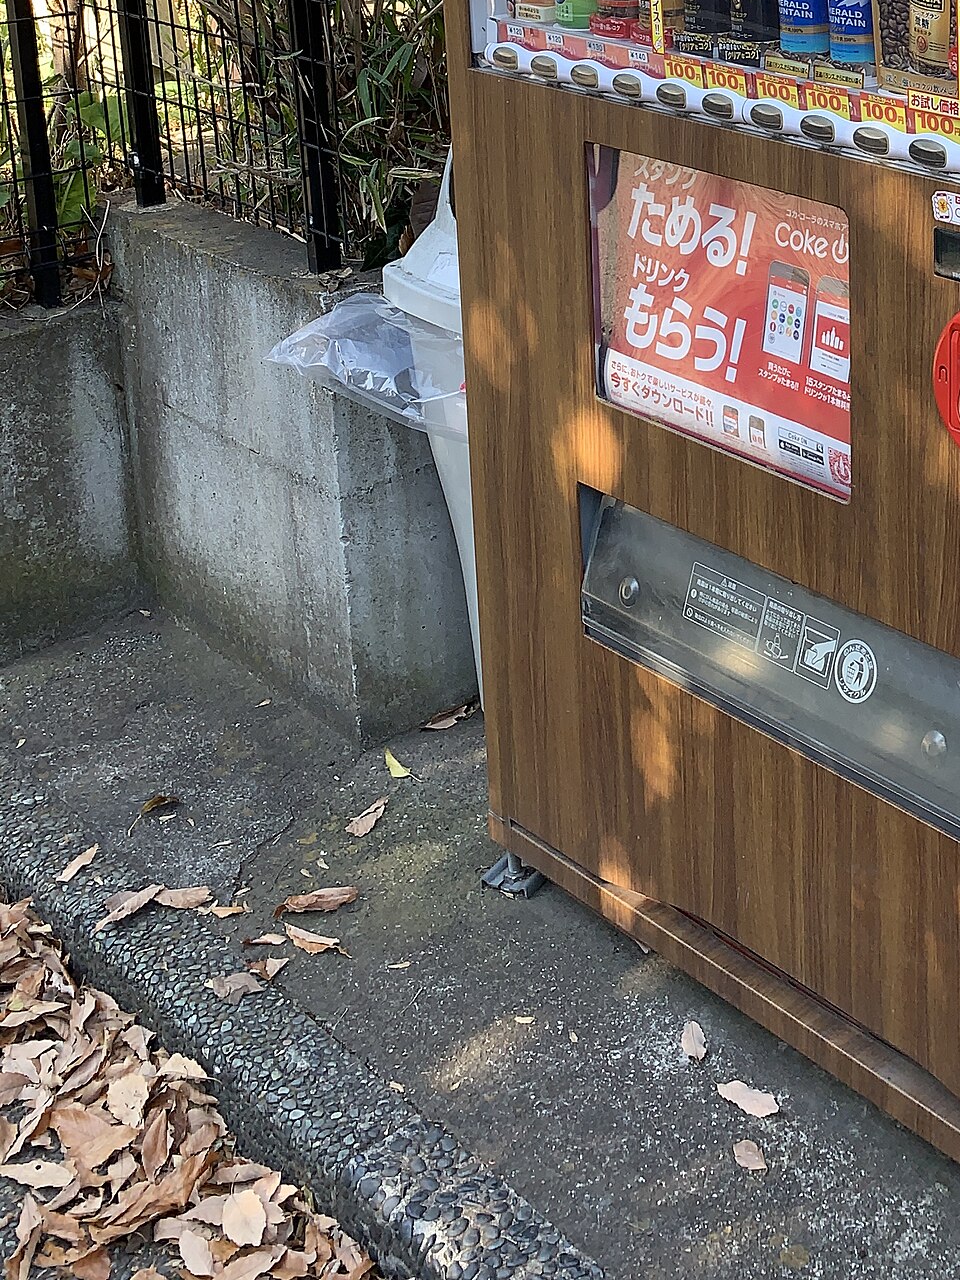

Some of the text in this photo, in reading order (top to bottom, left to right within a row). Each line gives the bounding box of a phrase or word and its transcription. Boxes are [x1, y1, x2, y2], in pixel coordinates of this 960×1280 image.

[667, 60, 701, 81] 100円
[708, 71, 744, 92] 100円
[759, 81, 797, 103] 100円
[809, 91, 848, 113] 100円
[862, 103, 905, 125] 100円
[911, 94, 959, 116] お試し価格
[917, 113, 960, 137] 100円
[635, 155, 699, 189] スタンプ
[627, 182, 757, 276] ためる!
[775, 222, 829, 259] Coke
[632, 253, 691, 292] ドリンク
[624, 281, 748, 384] もらう!
[767, 361, 792, 378] 買うたびに
[610, 372, 714, 428] 今すぐダウンロード!!
[839, 677, 867, 699] リサイクル
